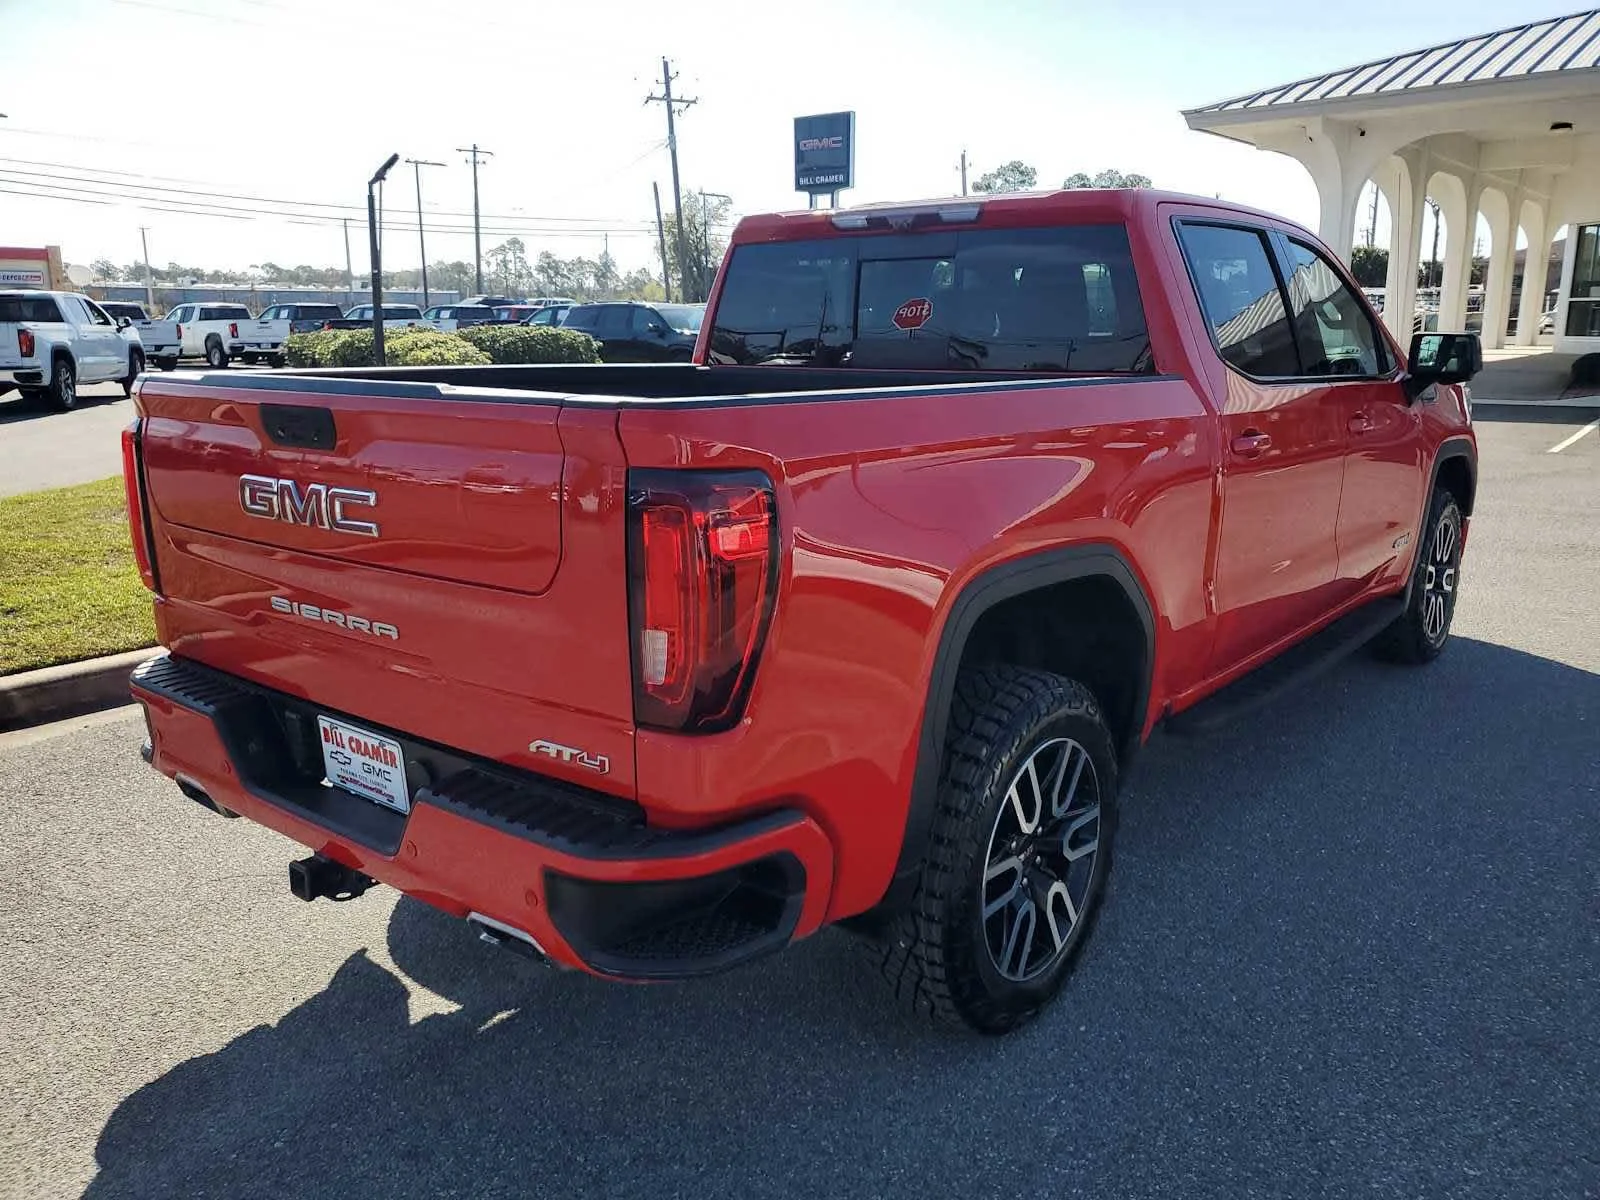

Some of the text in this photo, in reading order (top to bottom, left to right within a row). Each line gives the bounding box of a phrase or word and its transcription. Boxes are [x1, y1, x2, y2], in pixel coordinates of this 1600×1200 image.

[800, 136, 842, 151] GMC
[800, 174, 844, 185] BILL CRAMER
[239, 473, 380, 538] GMC
[270, 596, 399, 640] SIERRA
[322, 726, 398, 768] BILL CRAMER
[528, 739, 609, 775] AT4
[362, 762, 392, 782] GMC
